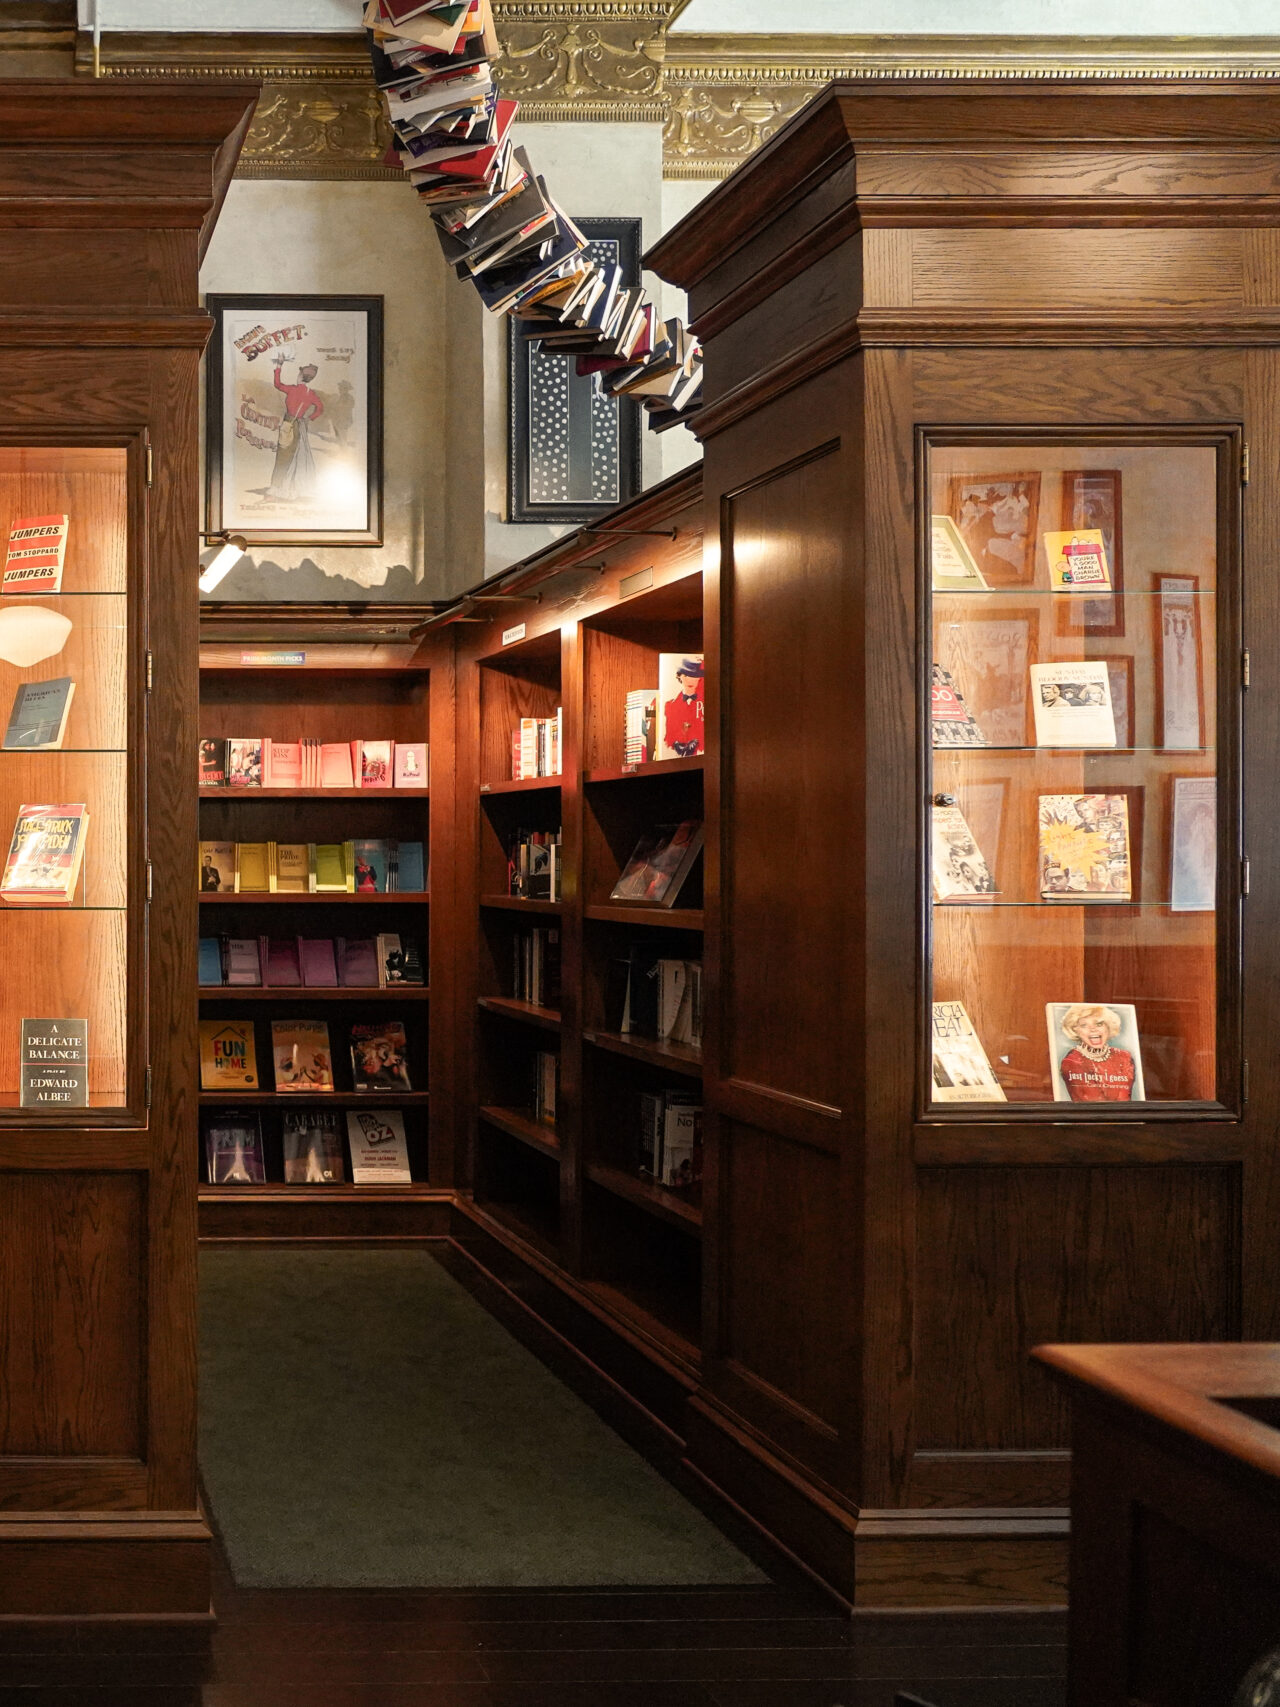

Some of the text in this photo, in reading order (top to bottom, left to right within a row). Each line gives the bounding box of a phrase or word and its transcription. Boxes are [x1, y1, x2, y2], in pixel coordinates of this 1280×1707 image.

[10, 526, 60, 540] JUMPERS
[23, 548, 59, 556] STOPPARD
[4, 567, 54, 582] JUMPERS
[51, 1024, 58, 1033] A
[27, 1037, 82, 1046] DELICATE
[213, 1040, 246, 1057] FUN
[29, 1049, 80, 1059] BALANCE
[214, 1057, 247, 1069] HOME
[29, 1078, 78, 1088] EDWARD
[36, 1092, 72, 1102] ALBEE
[283, 1111, 337, 1127] CABARET
